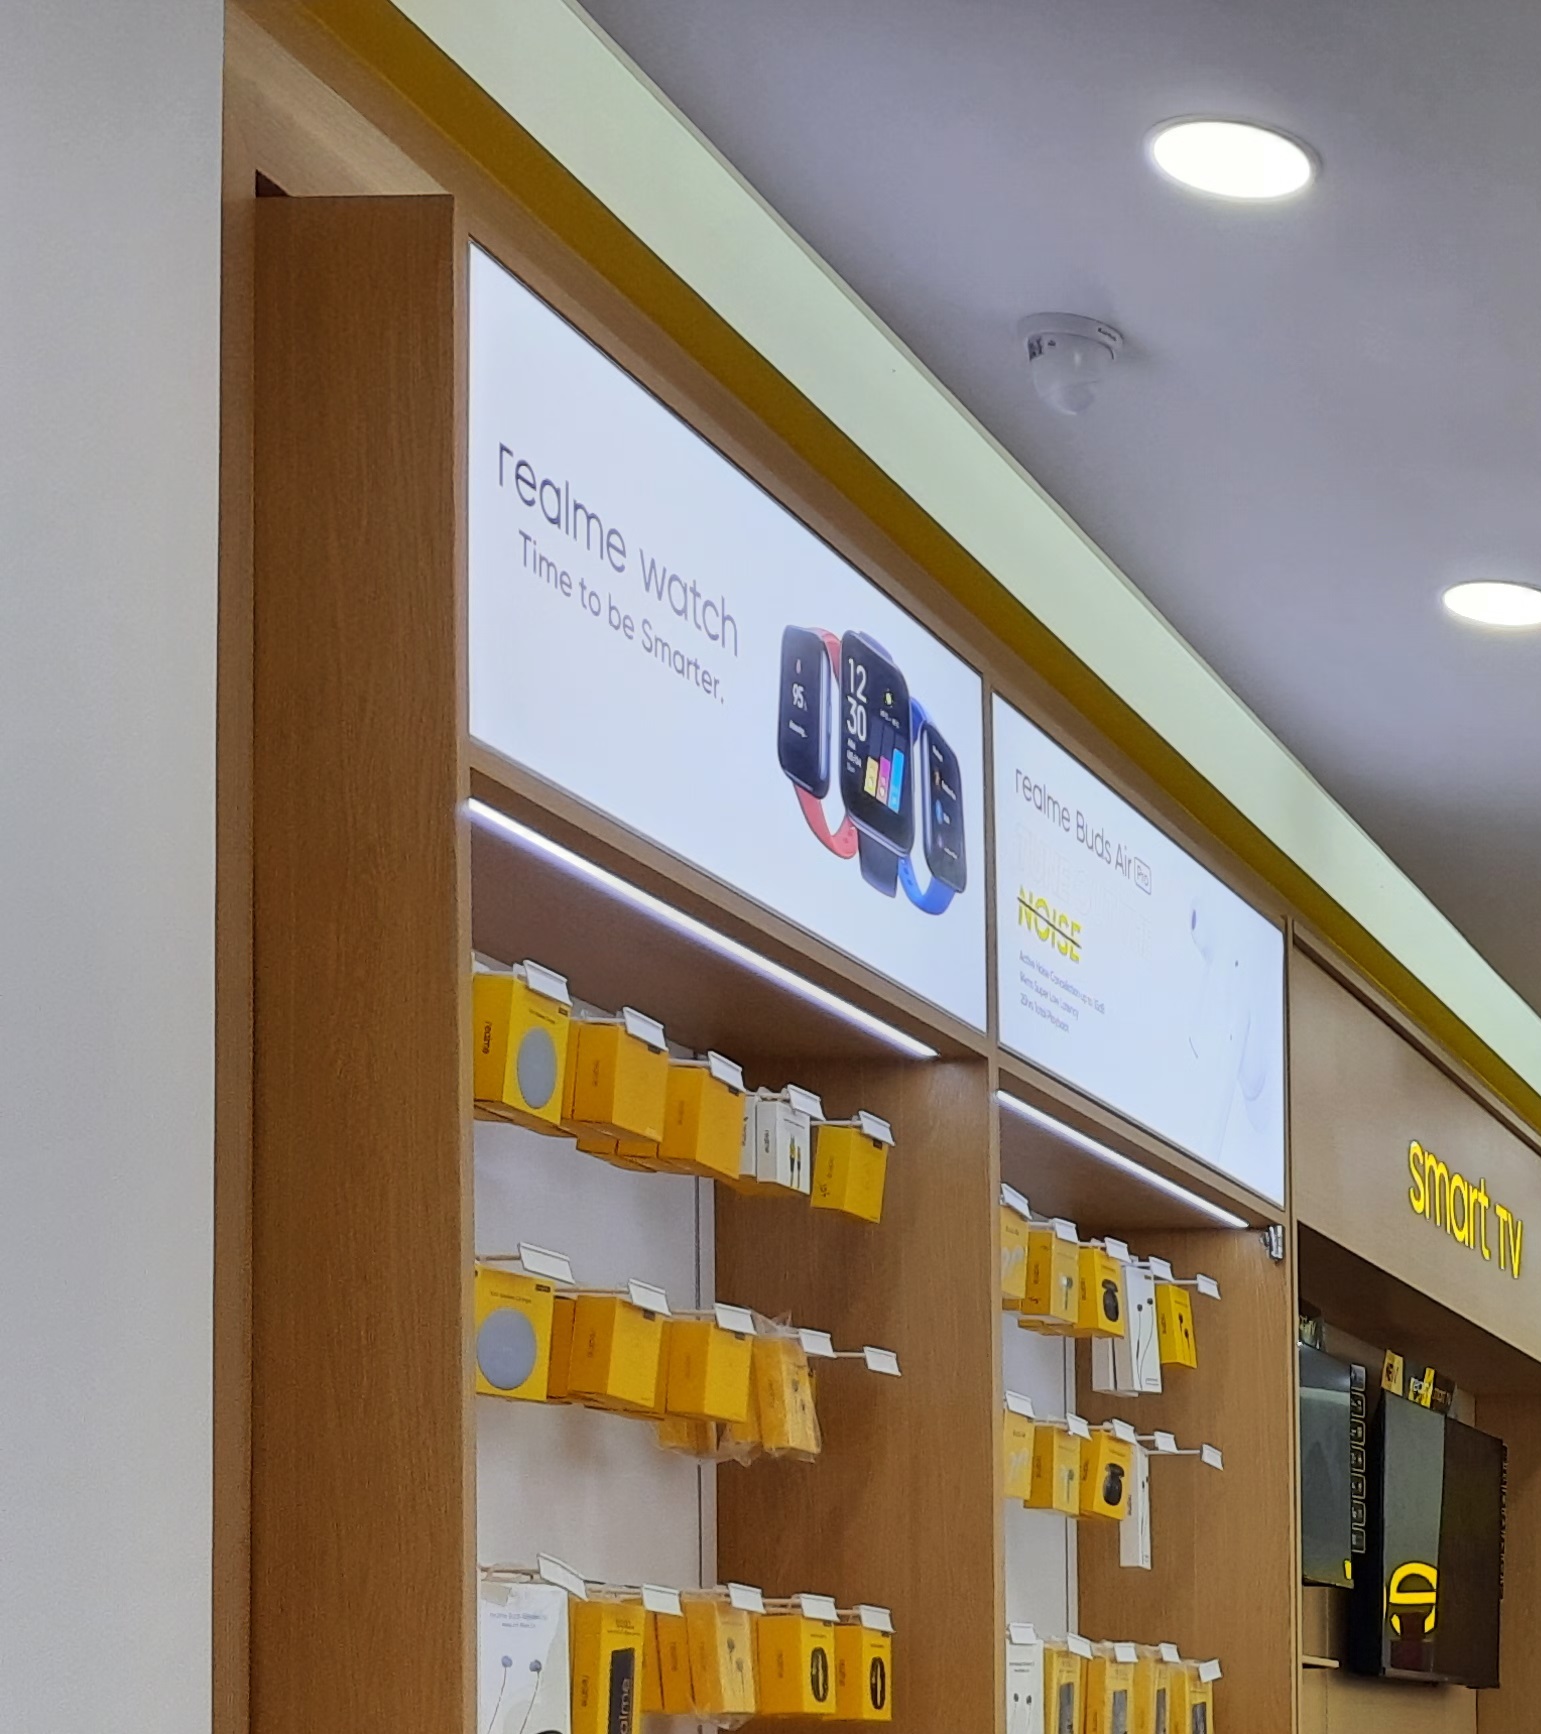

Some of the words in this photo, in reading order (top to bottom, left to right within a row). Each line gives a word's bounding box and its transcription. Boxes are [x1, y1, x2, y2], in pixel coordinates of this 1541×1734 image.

[498, 441, 627, 574] realme
[639, 547, 738, 657] watch
[518, 528, 572, 598] Time
[579, 577, 601, 617] to
[608, 592, 634, 640] be
[641, 618, 725, 705] Smarter.
[846, 695, 867, 742] 30
[848, 658, 867, 703] 12
[1015, 767, 1071, 832] realme
[1076, 809, 1111, 866] Buds
[1115, 843, 1132, 880] Air
[1018, 884, 1082, 964] NOISE
[1408, 1139, 1491, 1262] smart
[1494, 1203, 1524, 1280] TV
